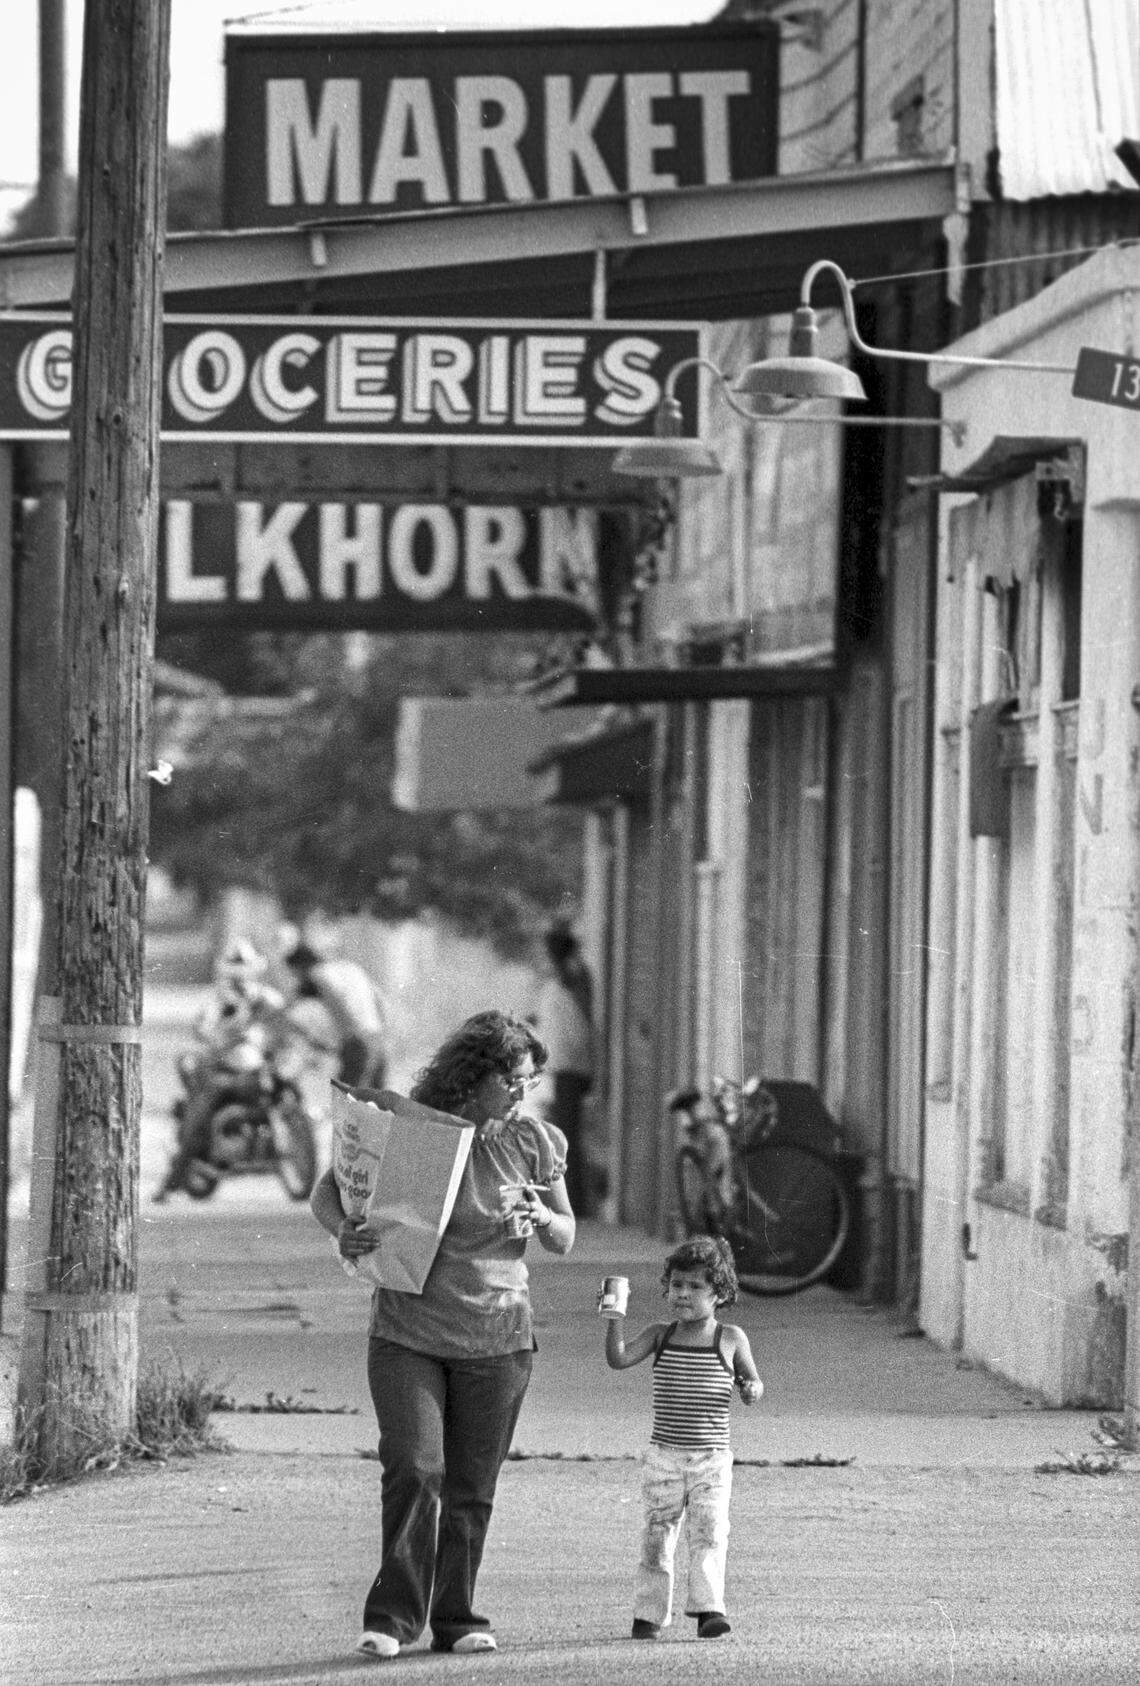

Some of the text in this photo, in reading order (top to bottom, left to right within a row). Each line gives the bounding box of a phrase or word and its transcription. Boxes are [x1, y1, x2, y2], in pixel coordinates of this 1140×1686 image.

[266, 70, 750, 206] MARKET
[17, 330, 662, 426] GOCERIES
[166, 501, 599, 602] LKHORN
